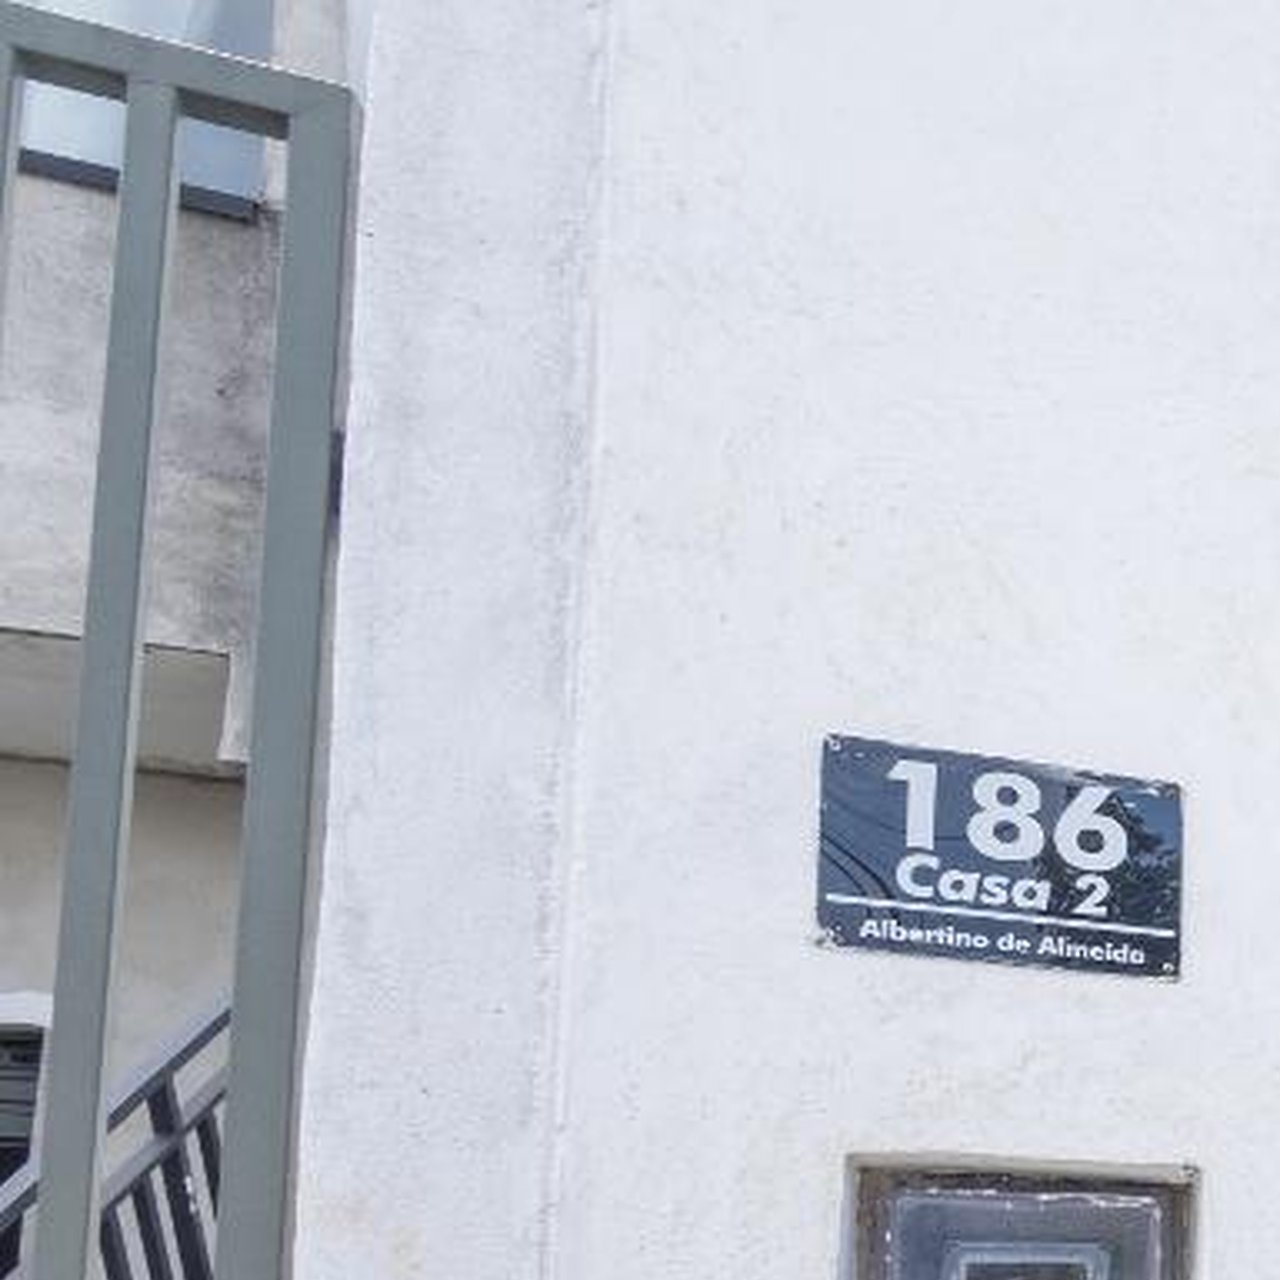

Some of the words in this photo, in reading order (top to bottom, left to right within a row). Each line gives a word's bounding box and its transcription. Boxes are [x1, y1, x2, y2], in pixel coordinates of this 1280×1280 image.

[887, 760, 1128, 871] 186
[895, 853, 1052, 910] Casa
[1072, 874, 1112, 917] 2
[859, 918, 990, 950] Albertino
[997, 932, 1030, 955] de
[1038, 937, 1146, 966] Almeida
